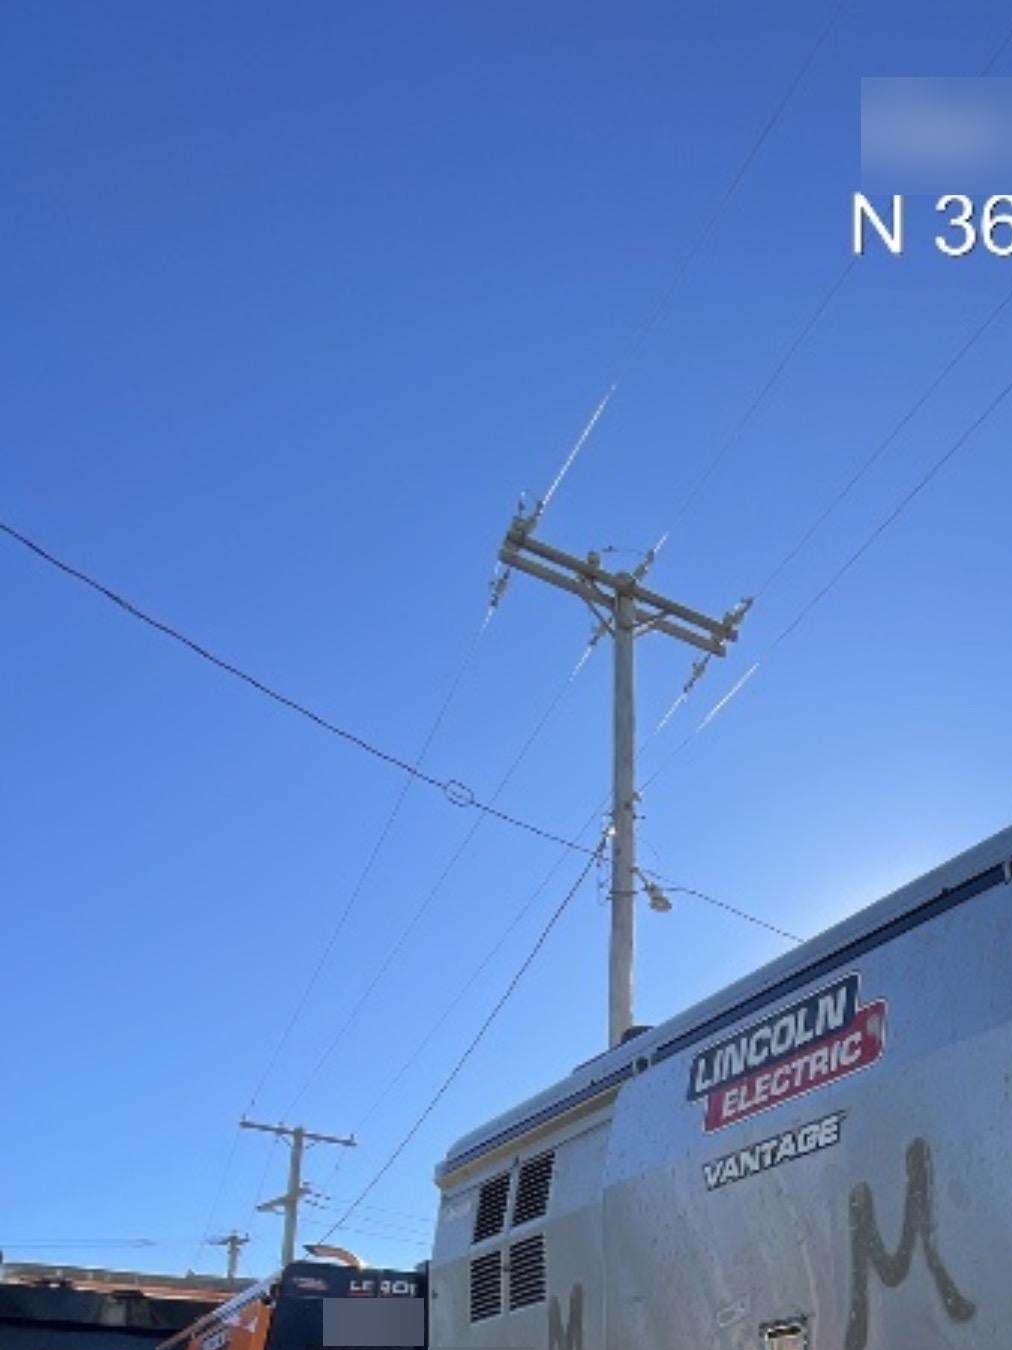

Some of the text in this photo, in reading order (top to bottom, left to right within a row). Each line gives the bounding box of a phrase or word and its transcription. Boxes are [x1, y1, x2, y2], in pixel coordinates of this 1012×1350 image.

[694, 985, 848, 1095] LINCOLN
[720, 1031, 863, 1119] ELECTRIC
[703, 1112, 844, 1190] VANTAGE
